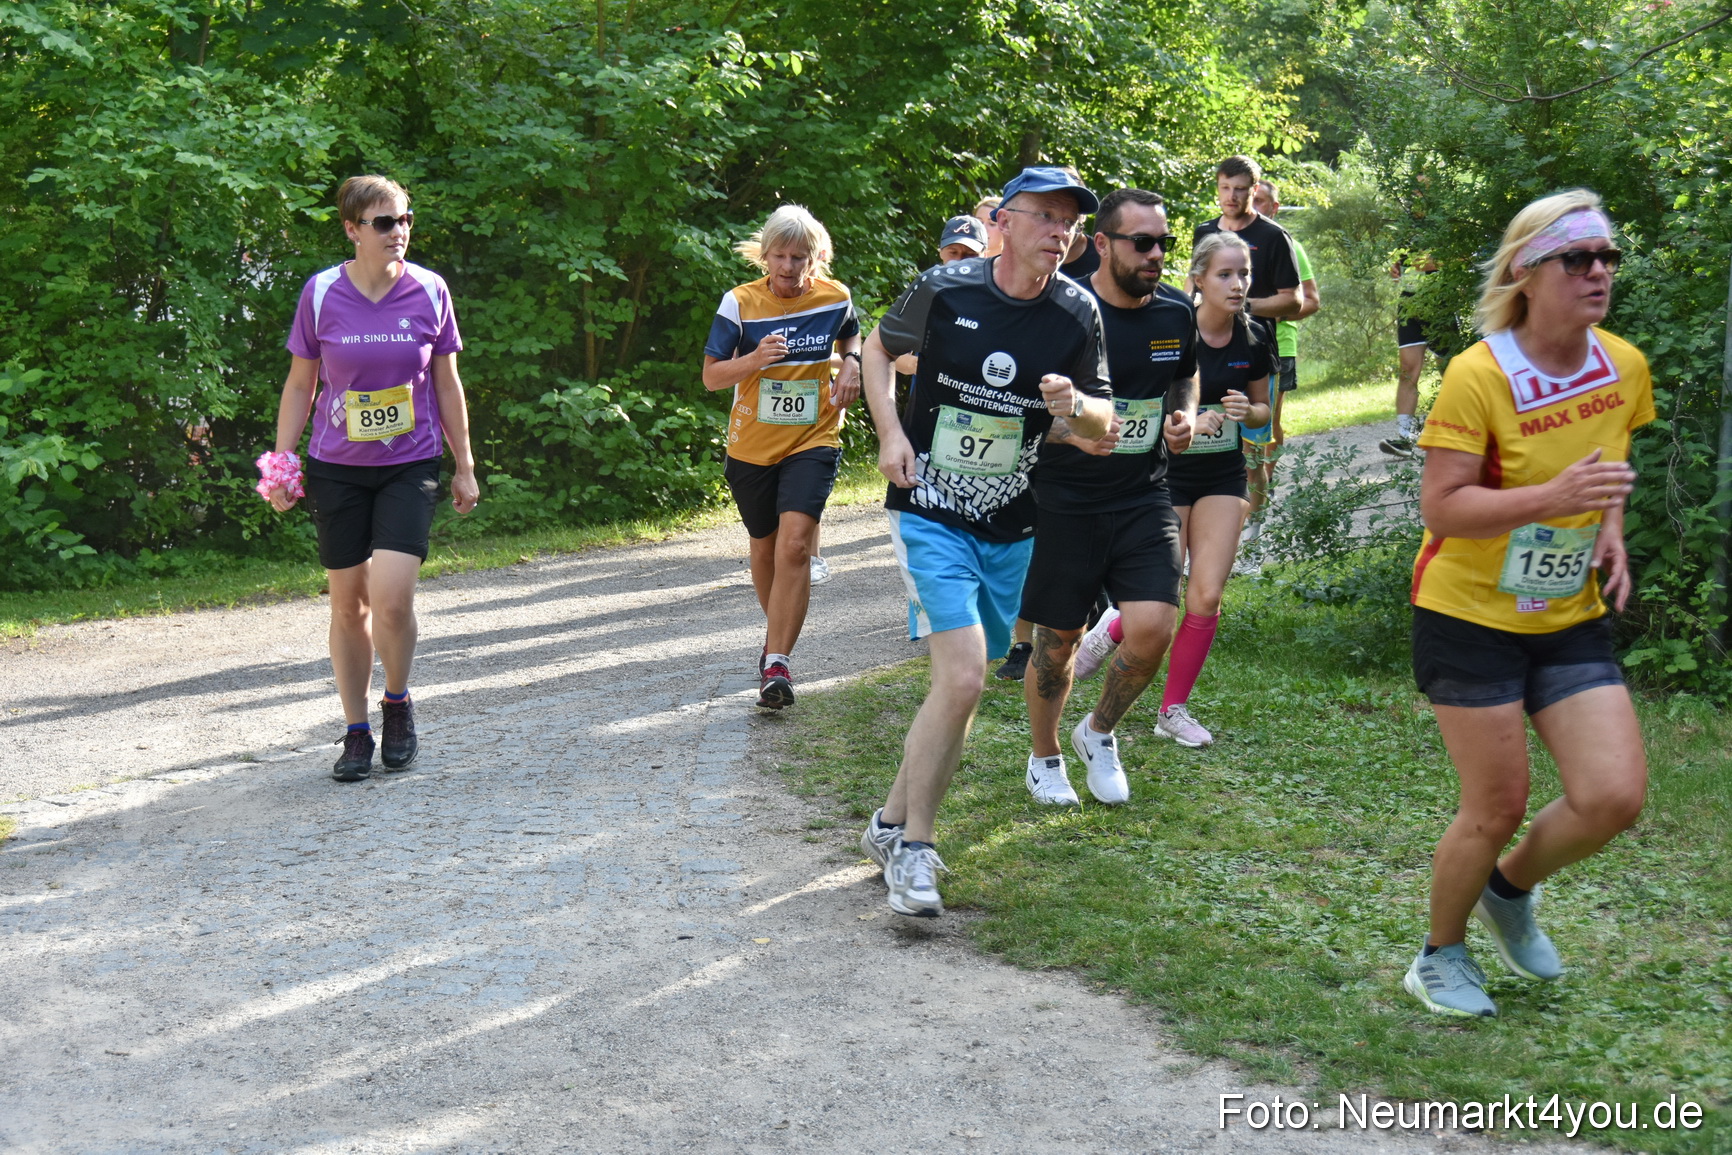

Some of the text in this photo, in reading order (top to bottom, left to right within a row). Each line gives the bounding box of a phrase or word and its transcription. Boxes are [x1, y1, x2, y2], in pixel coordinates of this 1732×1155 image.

[955, 317, 978, 330] JAKO
[341, 333, 416, 344] WIR SIND LILA.
[770, 396, 805, 412] 780
[959, 394, 1024, 416] SCHOTTERWERKE
[360, 406, 398, 428] 899
[1519, 392, 1625, 438] MAX BÖGL
[1122, 420, 1148, 438] 28
[959, 435, 994, 460] 97
[946, 454, 978, 466] Grommes
[1520, 550, 1585, 578] 1555
